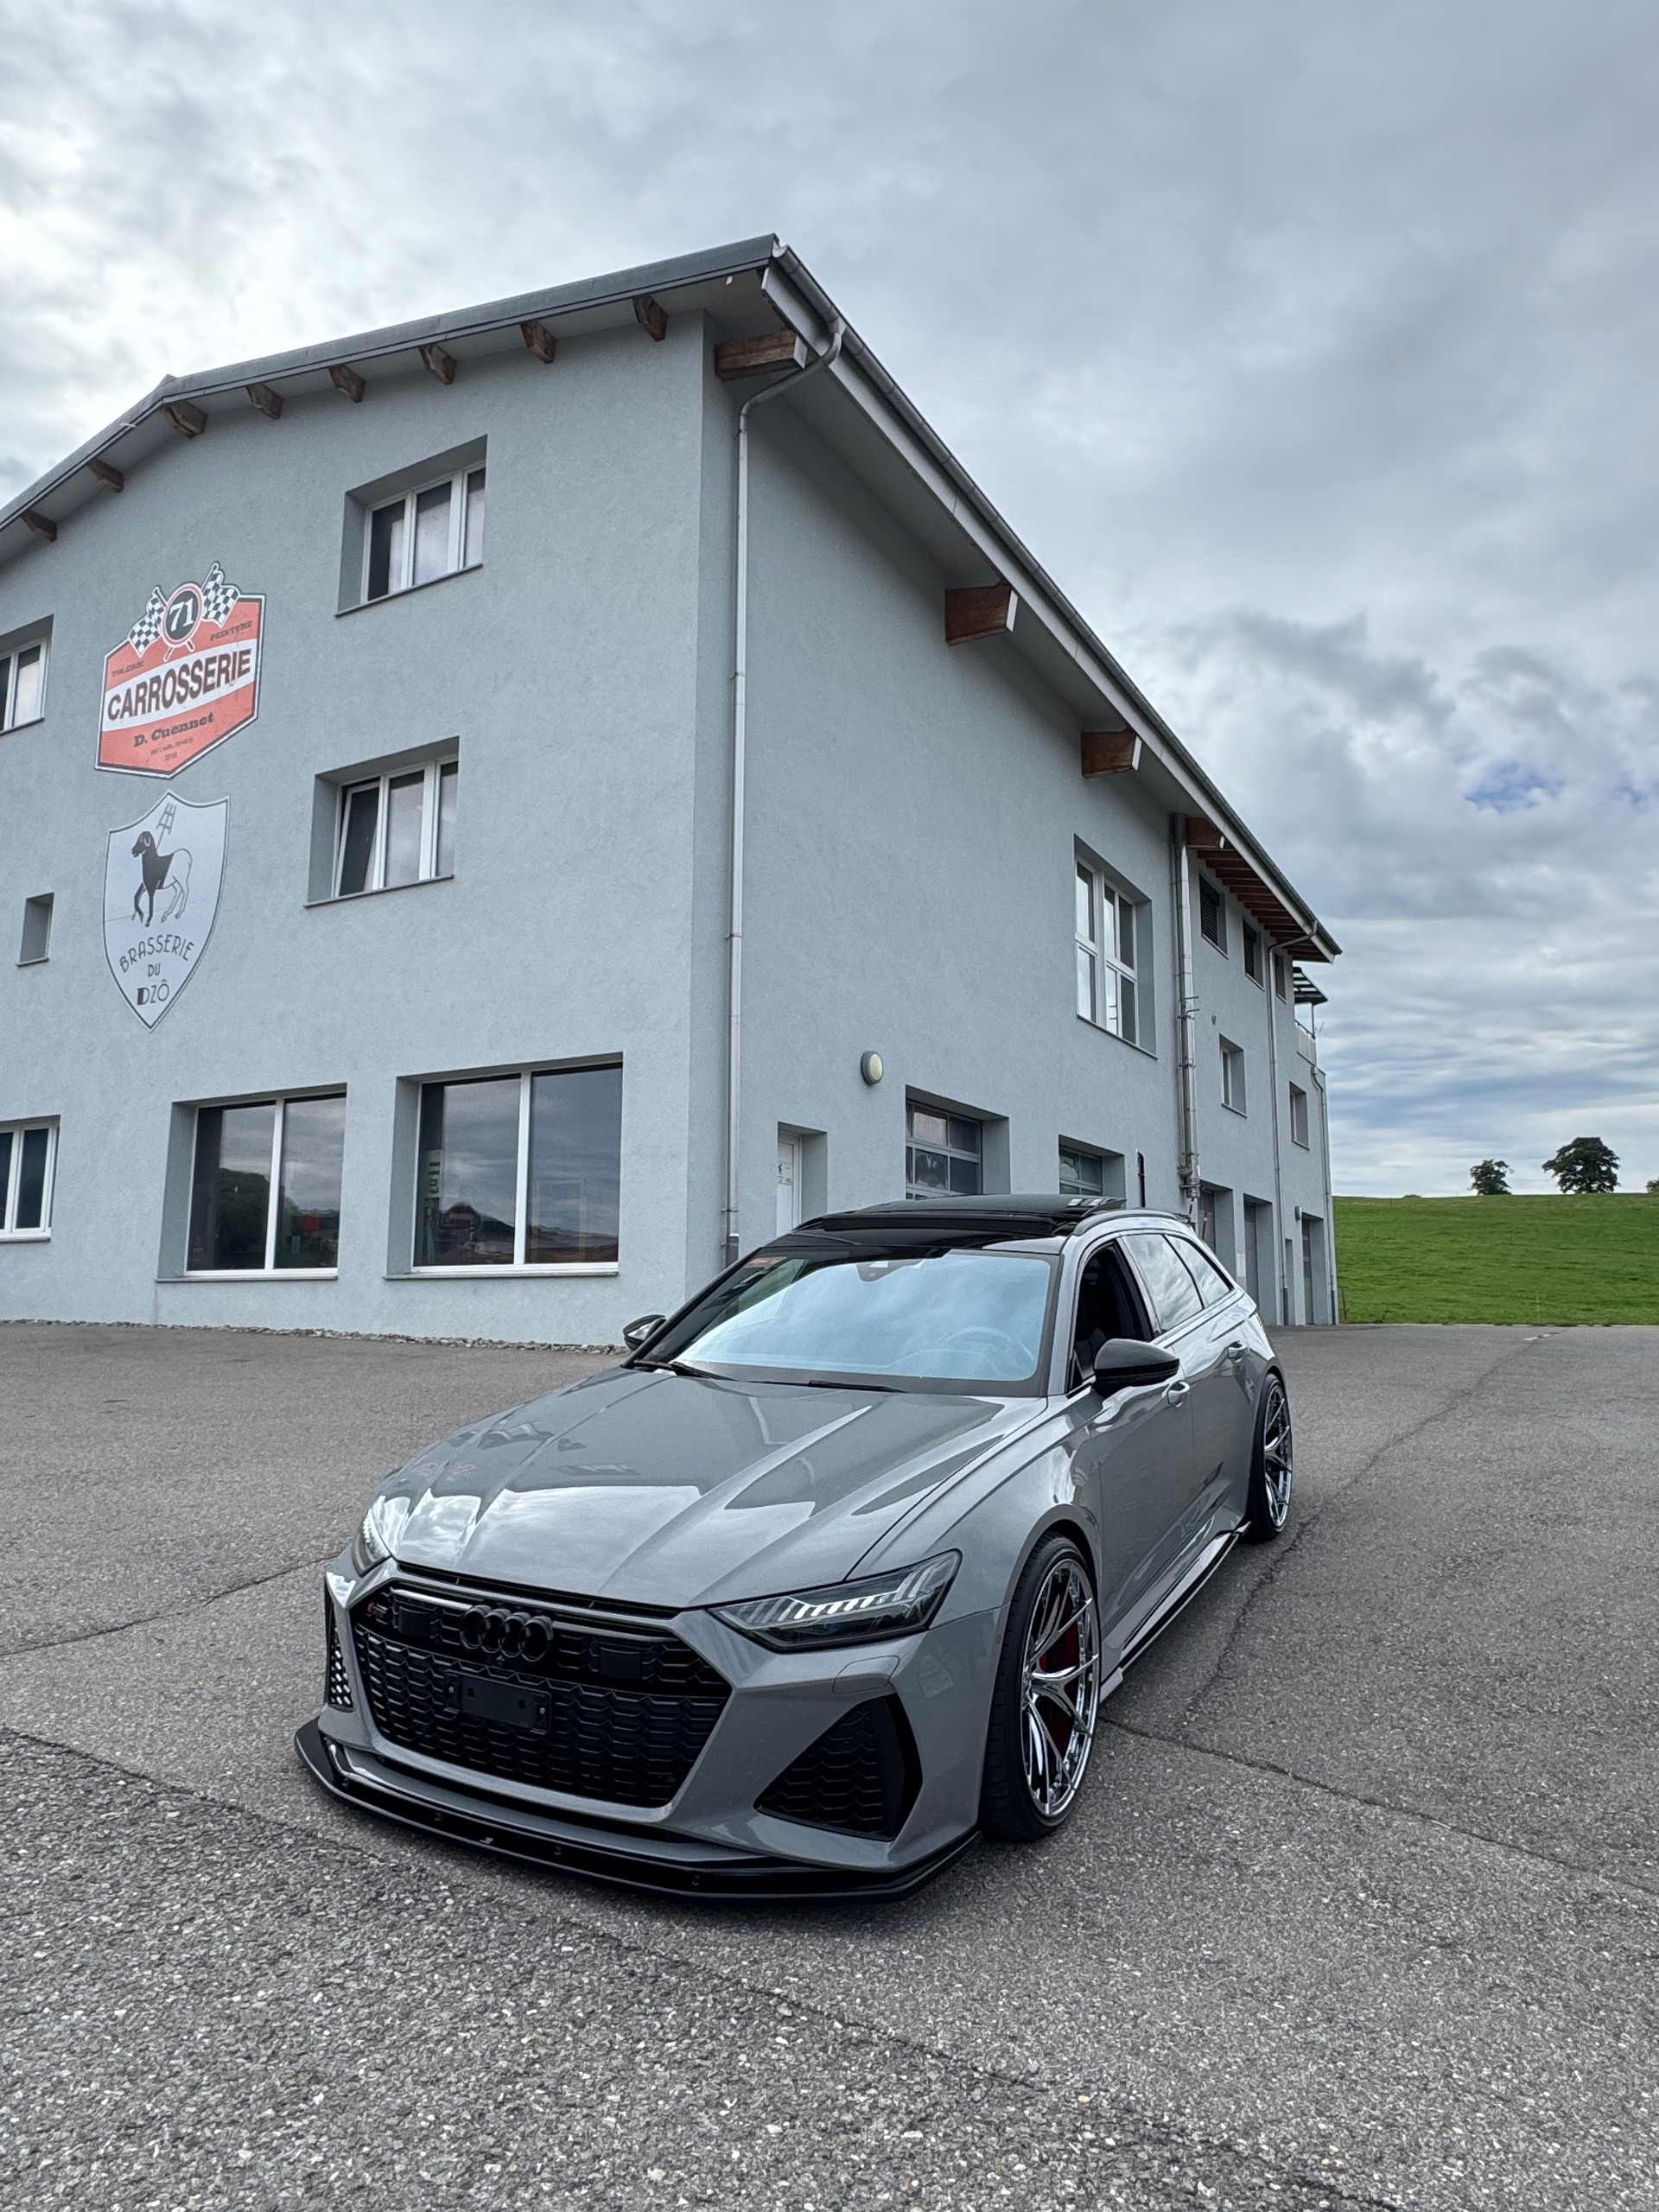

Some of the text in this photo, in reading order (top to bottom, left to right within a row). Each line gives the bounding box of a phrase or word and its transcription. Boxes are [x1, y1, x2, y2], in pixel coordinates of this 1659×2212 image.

[169, 598, 194, 632] 71
[107, 649, 252, 721] CARROSSERIE
[133, 734, 148, 747] D.
[119, 934, 194, 973] BRASSERIE
[148, 963, 161, 977] DU
[137, 979, 170, 1006] DZÔ
